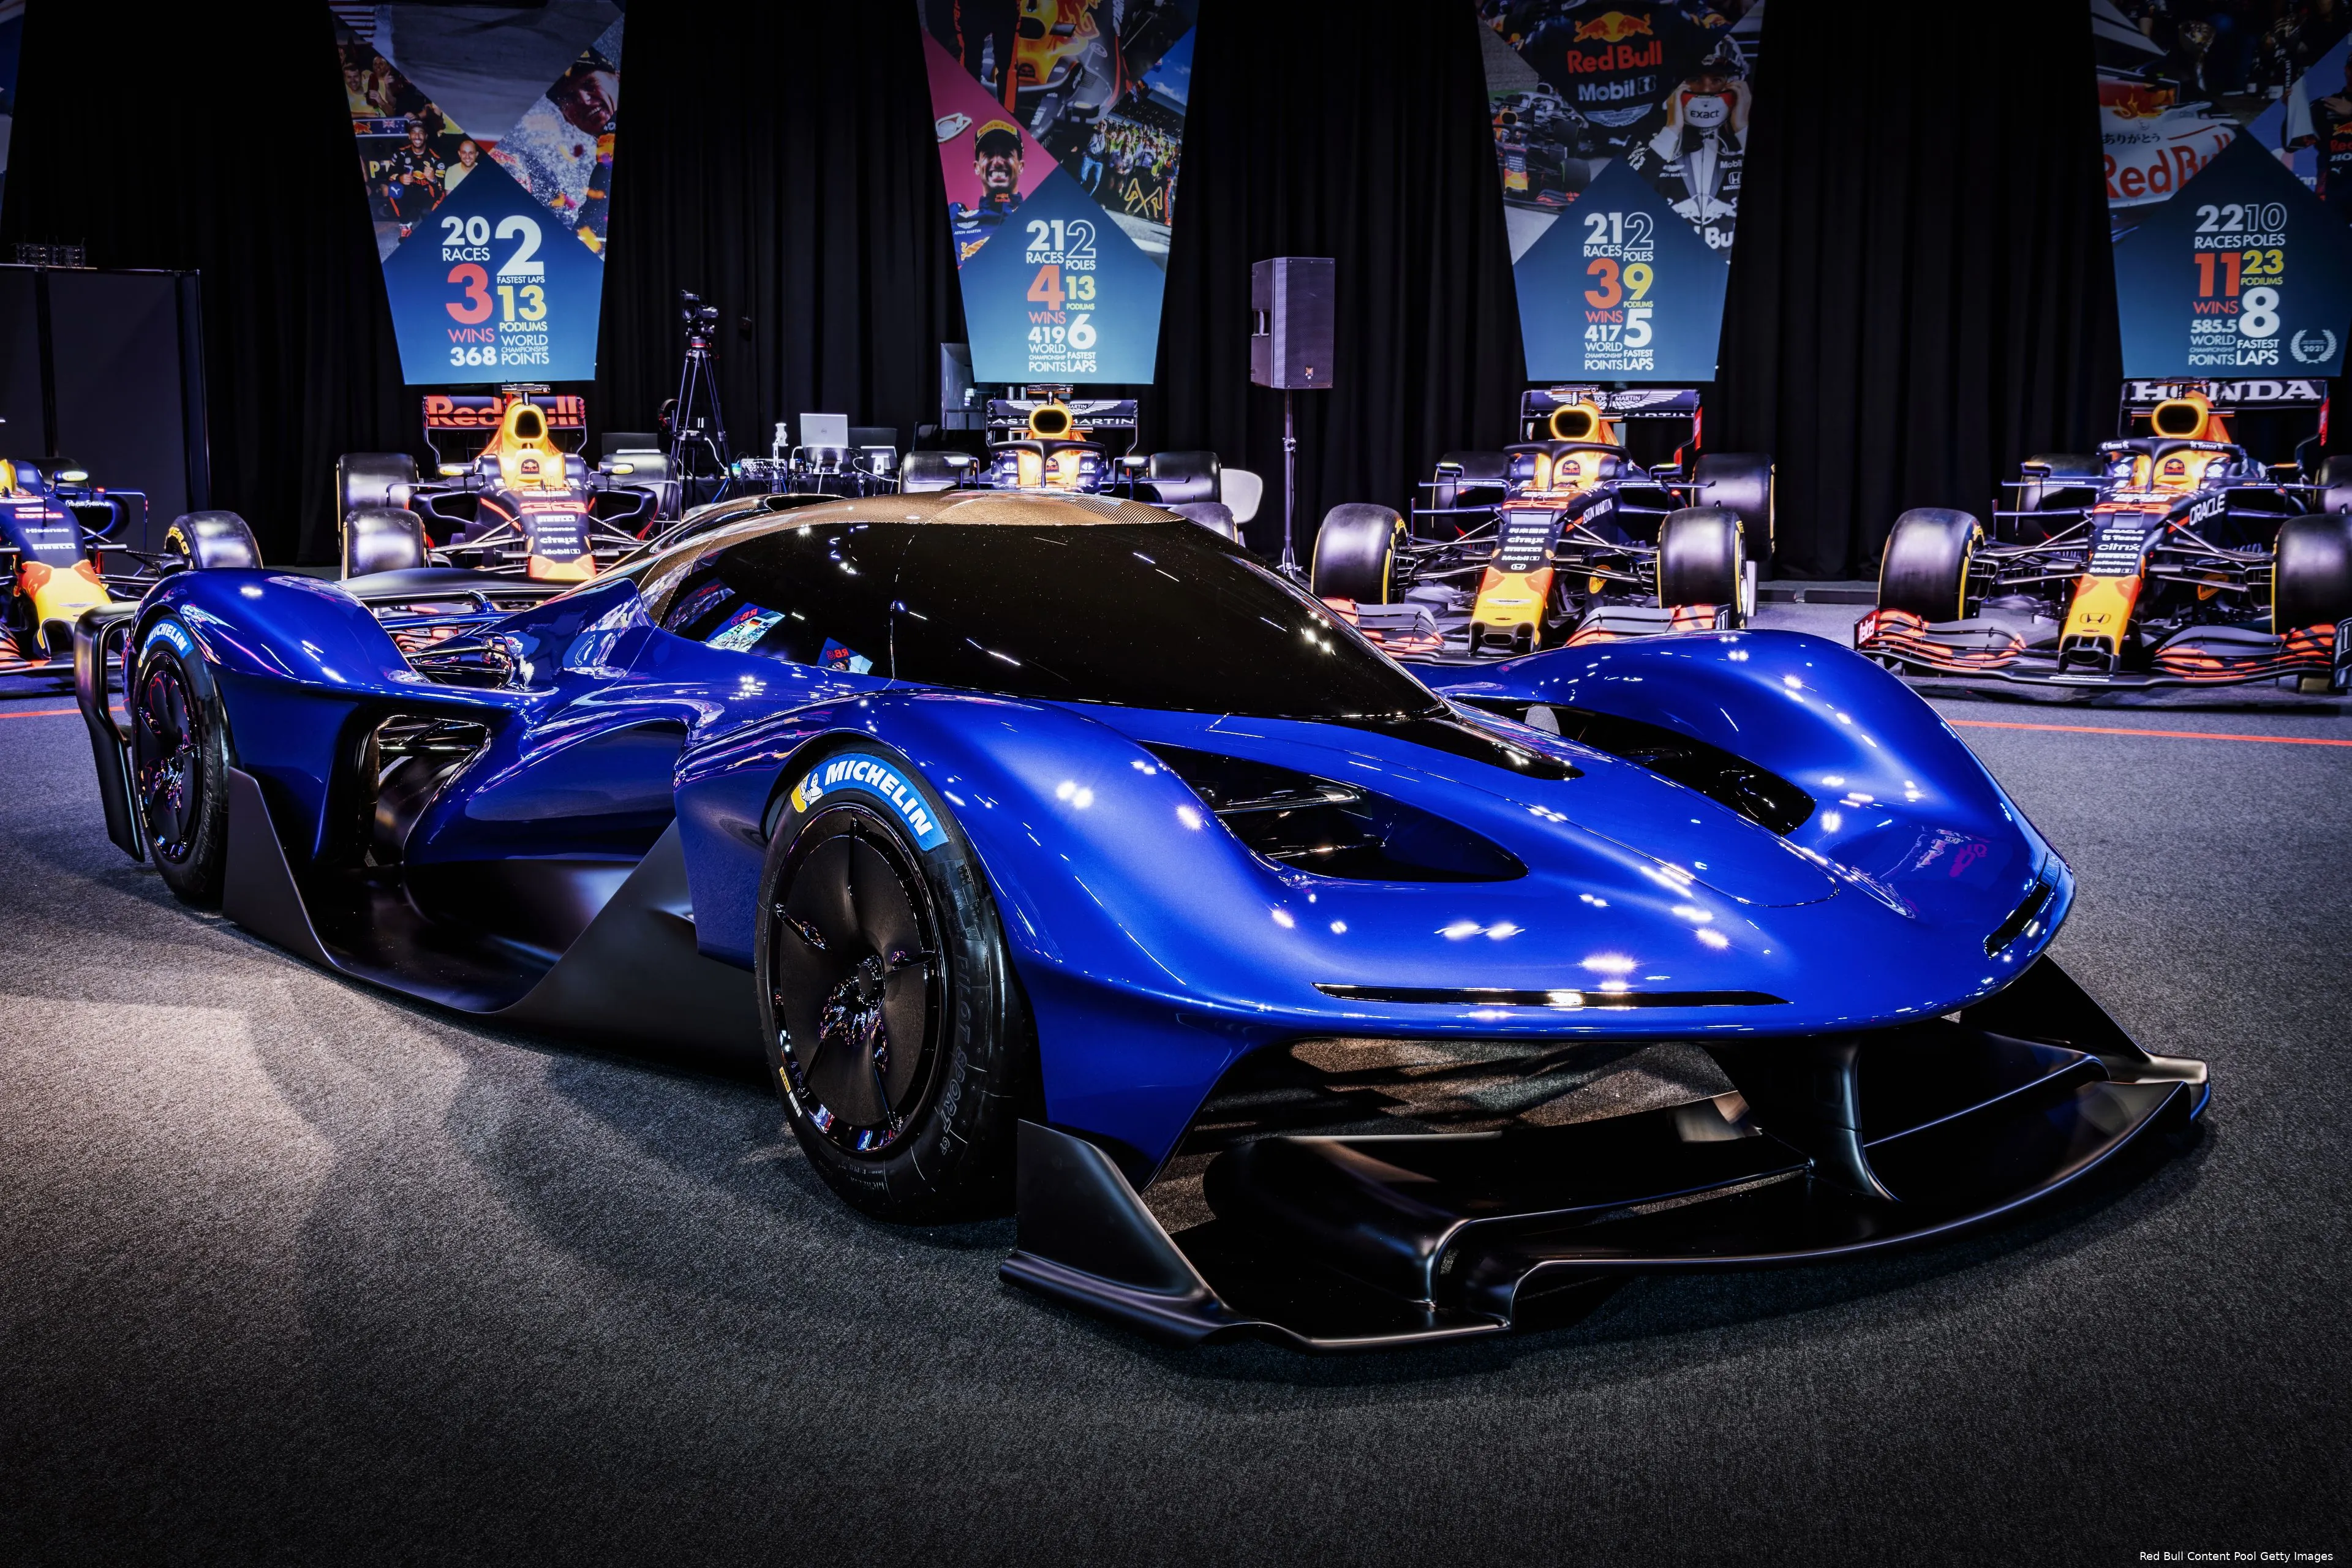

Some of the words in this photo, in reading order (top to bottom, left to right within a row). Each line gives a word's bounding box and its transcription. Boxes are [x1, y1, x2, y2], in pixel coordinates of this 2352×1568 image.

[1567, 45, 1614, 74] Red
[1616, 40, 1662, 69] Bull
[1578, 78, 1635, 101] Mobil
[2103, 149, 2171, 198] Red
[2169, 134, 2230, 189] Bll
[2195, 204, 2244, 232] 22
[2245, 202, 2287, 232] 10
[441, 216, 490, 246] 20
[1026, 219, 1064, 251] 21
[1066, 219, 1096, 258] 2
[1584, 213, 1622, 244] 21
[1624, 212, 1654, 251] 2
[495, 215, 545, 276] 2
[2195, 235, 2241, 249] RACES
[2243, 233, 2286, 247] POLES
[442, 247, 490, 261] RACES
[1026, 252, 1064, 263] RACES
[1583, 245, 1622, 257] RACES
[1623, 252, 1653, 262] POLES
[1066, 260, 1096, 270] POLES
[2242, 249, 2284, 274] 23
[1585, 258, 1622, 309] 3
[1623, 263, 1654, 300] 9
[2195, 252, 2241, 297] 11
[2241, 277, 2283, 285] PODIUMS
[446, 263, 493, 324] 3
[1027, 265, 1065, 311] 4
[1066, 276, 1096, 301] 13
[497, 285, 547, 322] 13
[2193, 301, 2239, 314] WINS
[2239, 287, 2280, 338] 8
[1028, 311, 1066, 324] WINS
[1585, 310, 1623, 323] WINS
[2190, 318, 2237, 333] 585.5
[448, 328, 495, 343] WINS
[500, 322, 548, 332] PODIUMS
[1028, 326, 1066, 344] 419
[1068, 314, 1096, 350] 6
[1585, 325, 1622, 341] 417
[1624, 309, 1652, 348] 5
[500, 334, 548, 346] WORLD
[1029, 344, 1066, 353] WORLD
[1585, 342, 1623, 352] WORLD
[2190, 335, 2236, 345] WORLD
[2237, 339, 2280, 349] FASTEST
[450, 346, 497, 366] 368
[501, 352, 549, 365] POINTS
[1068, 360, 1097, 372] LAPS
[1585, 359, 1623, 370] POINTS
[1624, 358, 1654, 371] LAPS
[2188, 353, 2235, 365] POINTS
[2236, 349, 2279, 366] LAPS
[1029, 361, 1066, 372] POINTS
[427, 396, 502, 426] Red
[520, 502, 587, 514] 33
[2189, 494, 2225, 526] ORACLE
[147, 623, 187, 651] MICHELIN
[824, 760, 933, 837] MICHELIN
[956, 955, 971, 1044] PILOT
[940, 1046, 968, 1134] SPORT
[939, 1136, 950, 1156] GT
